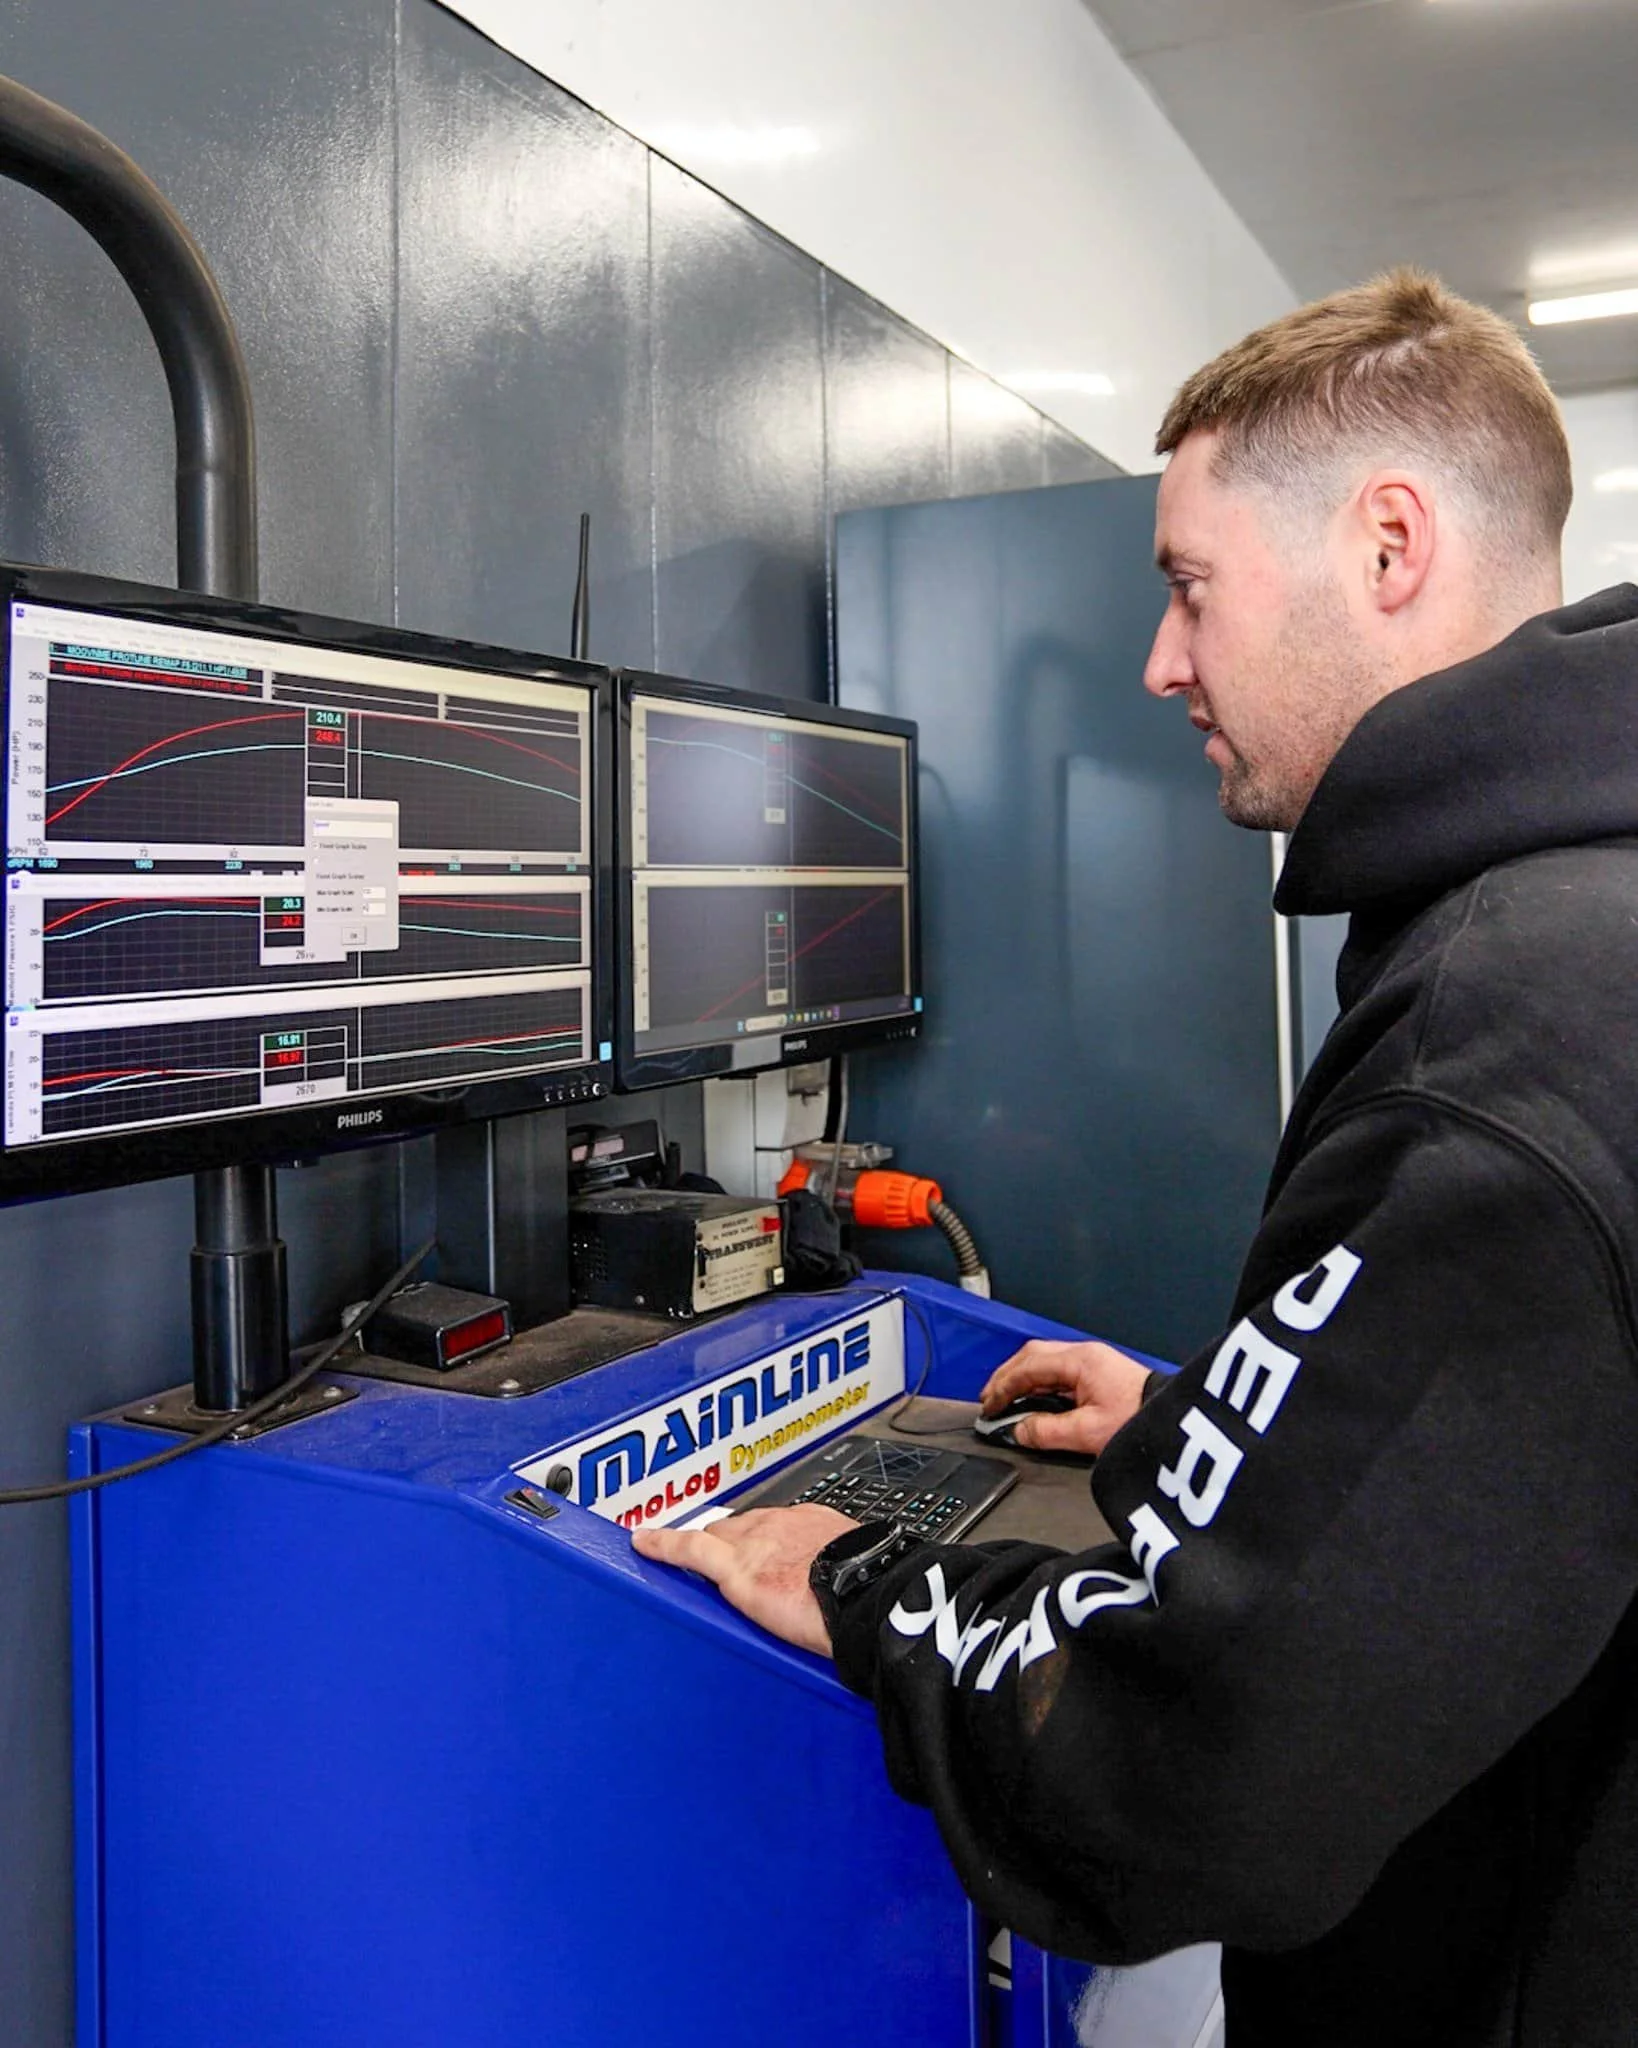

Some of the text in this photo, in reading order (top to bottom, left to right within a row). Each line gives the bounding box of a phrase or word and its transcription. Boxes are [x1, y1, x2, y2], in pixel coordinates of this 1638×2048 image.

[316, 711, 342, 724] 210.4
[337, 1109, 383, 1129] PHILIPS
[729, 1380, 871, 1474] Dynamometer
